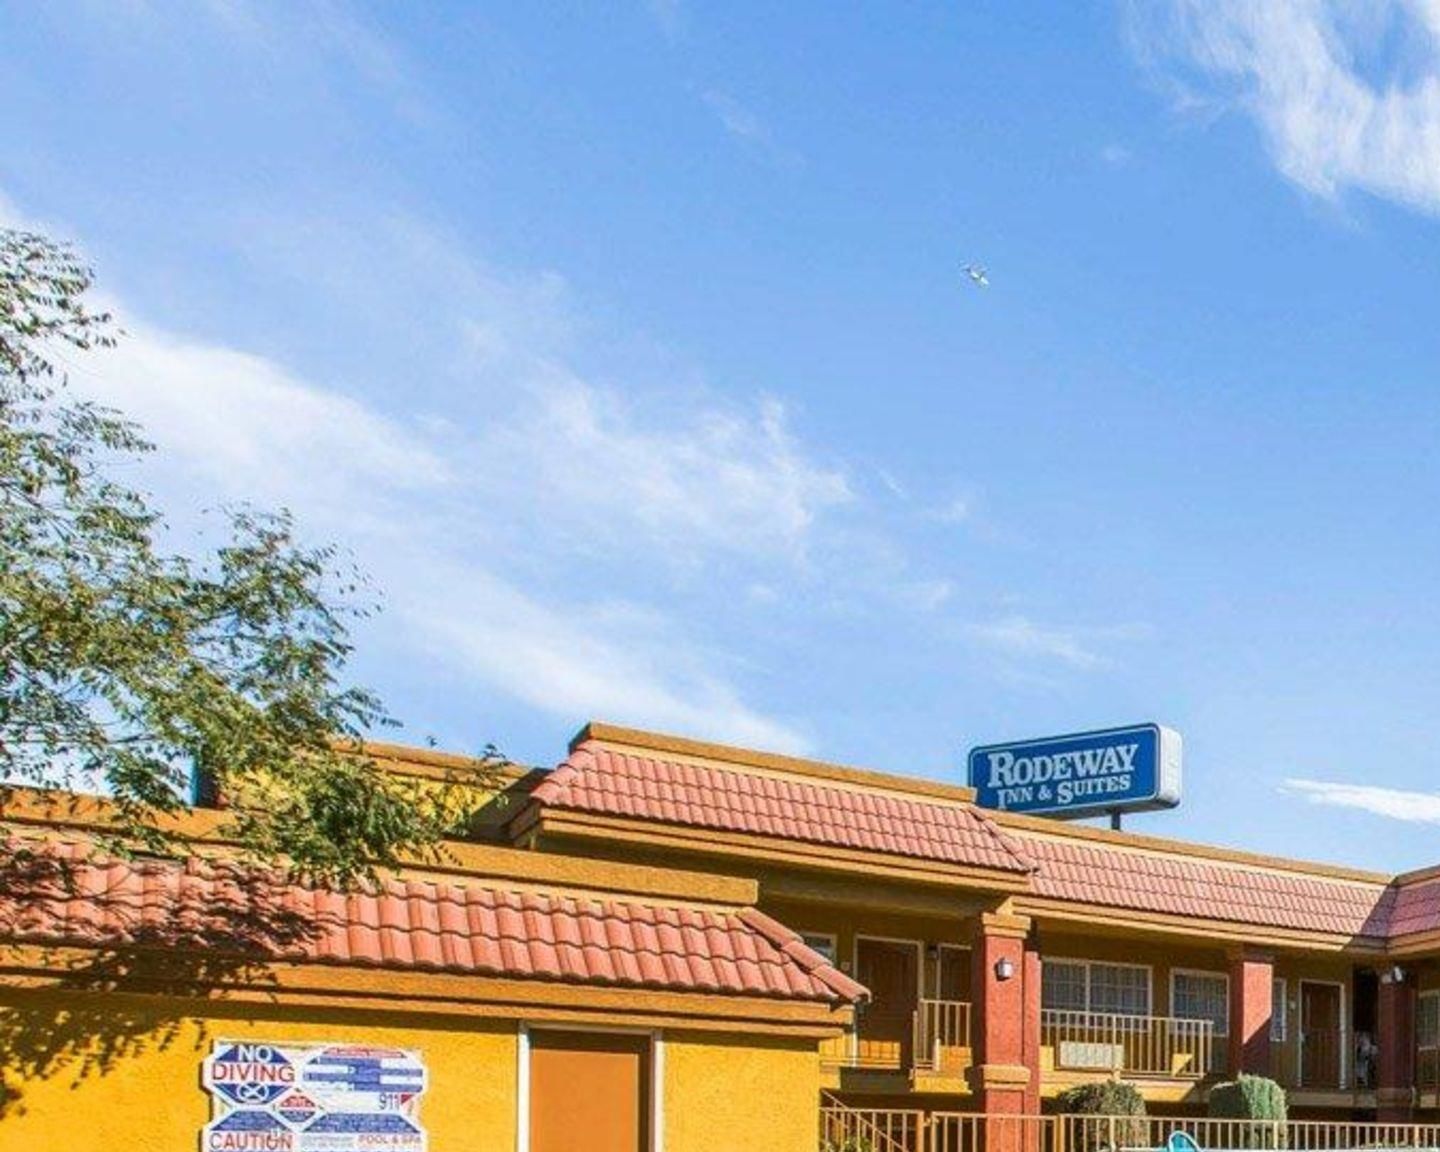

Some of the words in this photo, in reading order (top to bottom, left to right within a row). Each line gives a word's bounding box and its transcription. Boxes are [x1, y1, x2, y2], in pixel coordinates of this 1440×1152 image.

[987, 744, 1138, 788] RODEWAY
[997, 787, 1033, 809] INN
[1038, 785, 1052, 800] &
[1057, 774, 1131, 804] SUITES
[238, 1045, 272, 1063] NO
[212, 1063, 295, 1082] DIVING
[379, 1092, 400, 1110] 911
[209, 1132, 293, 1151] CAUTION
